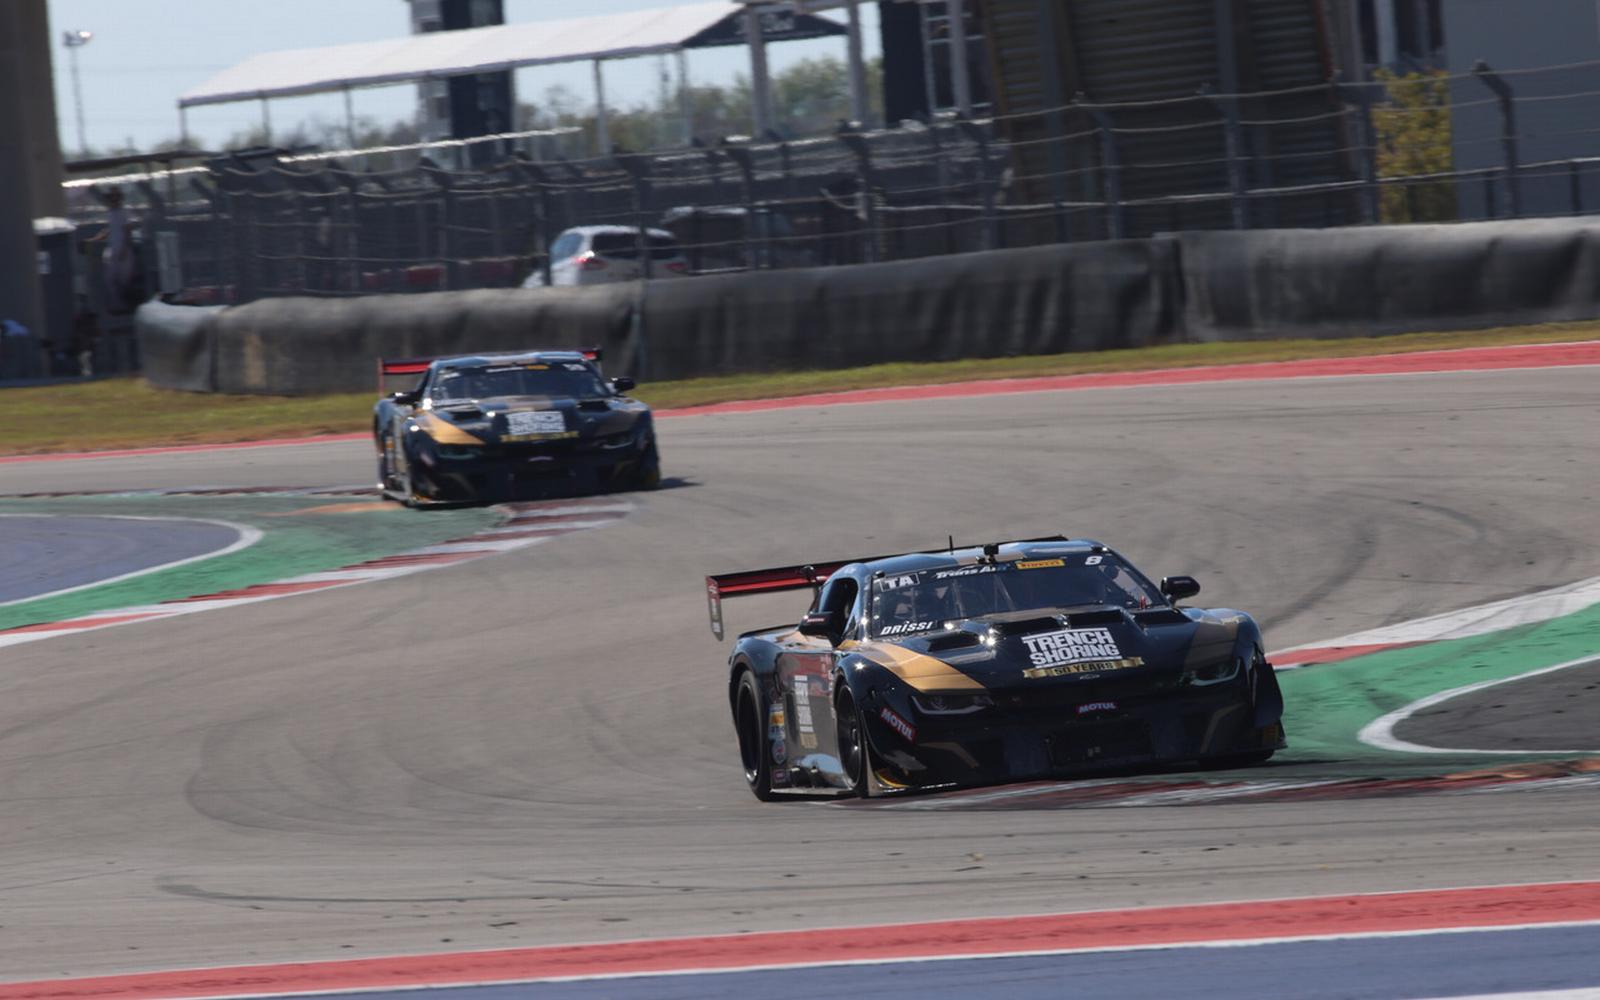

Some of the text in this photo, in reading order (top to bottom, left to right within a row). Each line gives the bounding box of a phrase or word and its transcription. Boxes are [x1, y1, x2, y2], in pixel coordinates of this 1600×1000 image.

[1084, 556, 1104, 566] 8
[935, 567, 978, 579] Trans
[885, 575, 915, 589] TA
[1022, 630, 1115, 653] TRENCH
[1029, 643, 1121, 665] SHORING
[1055, 662, 1114, 676] 50 YEARS
[1079, 702, 1117, 713] MOTUL
[881, 708, 913, 741] MOTUL
